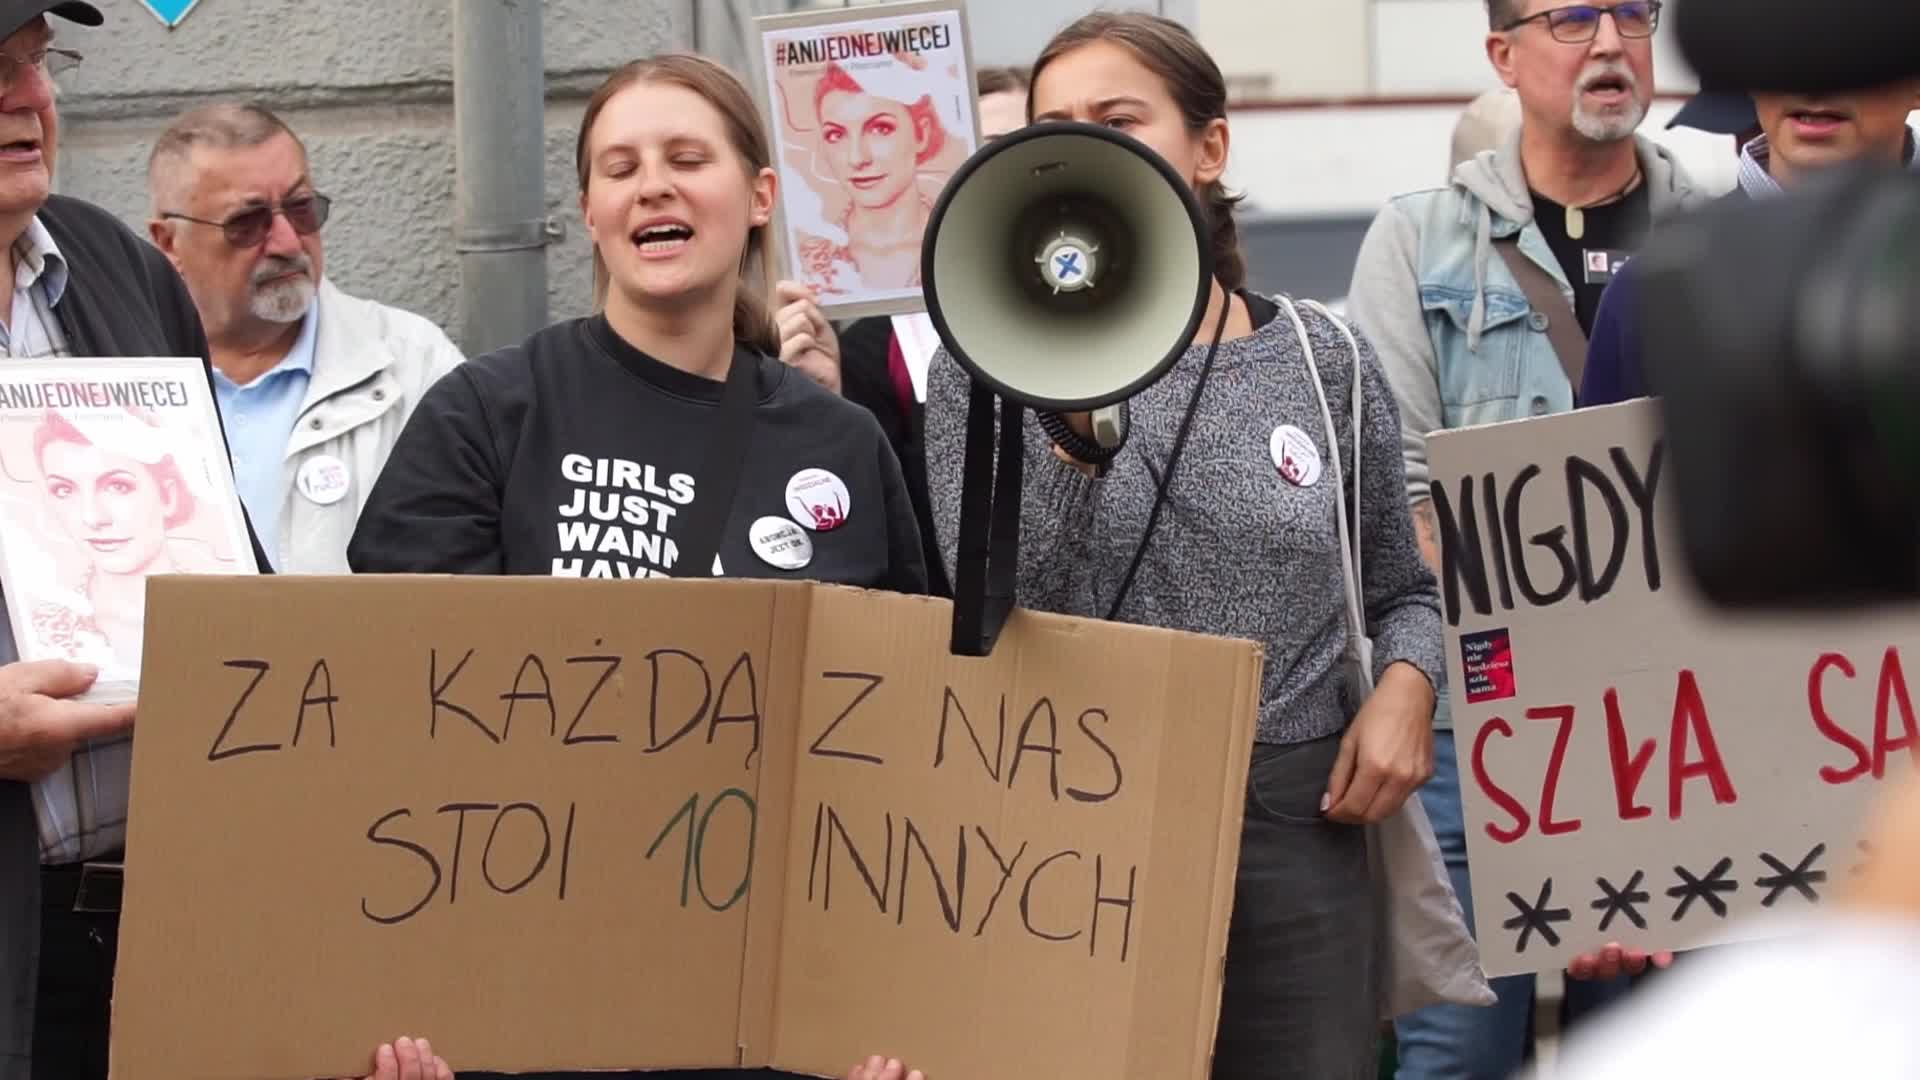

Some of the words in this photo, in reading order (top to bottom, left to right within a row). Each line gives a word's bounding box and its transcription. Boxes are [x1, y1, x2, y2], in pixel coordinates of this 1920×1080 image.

[776, 24, 950, 66] #ANIJEDNEJWIĘCEJ
[558, 488, 677, 533] JUST
[561, 453, 695, 504] GIRLS
[1430, 437, 1664, 626] NIGDY
[207, 657, 339, 761] ZA
[430, 638, 761, 770] KAŻDĄ
[809, 671, 884, 764] Z
[934, 685, 1123, 802] NAS
[1470, 669, 1738, 844] SZŁA
[360, 801, 576, 924] STOI
[644, 787, 757, 912] 10
[808, 801, 1136, 962] INNYCH
